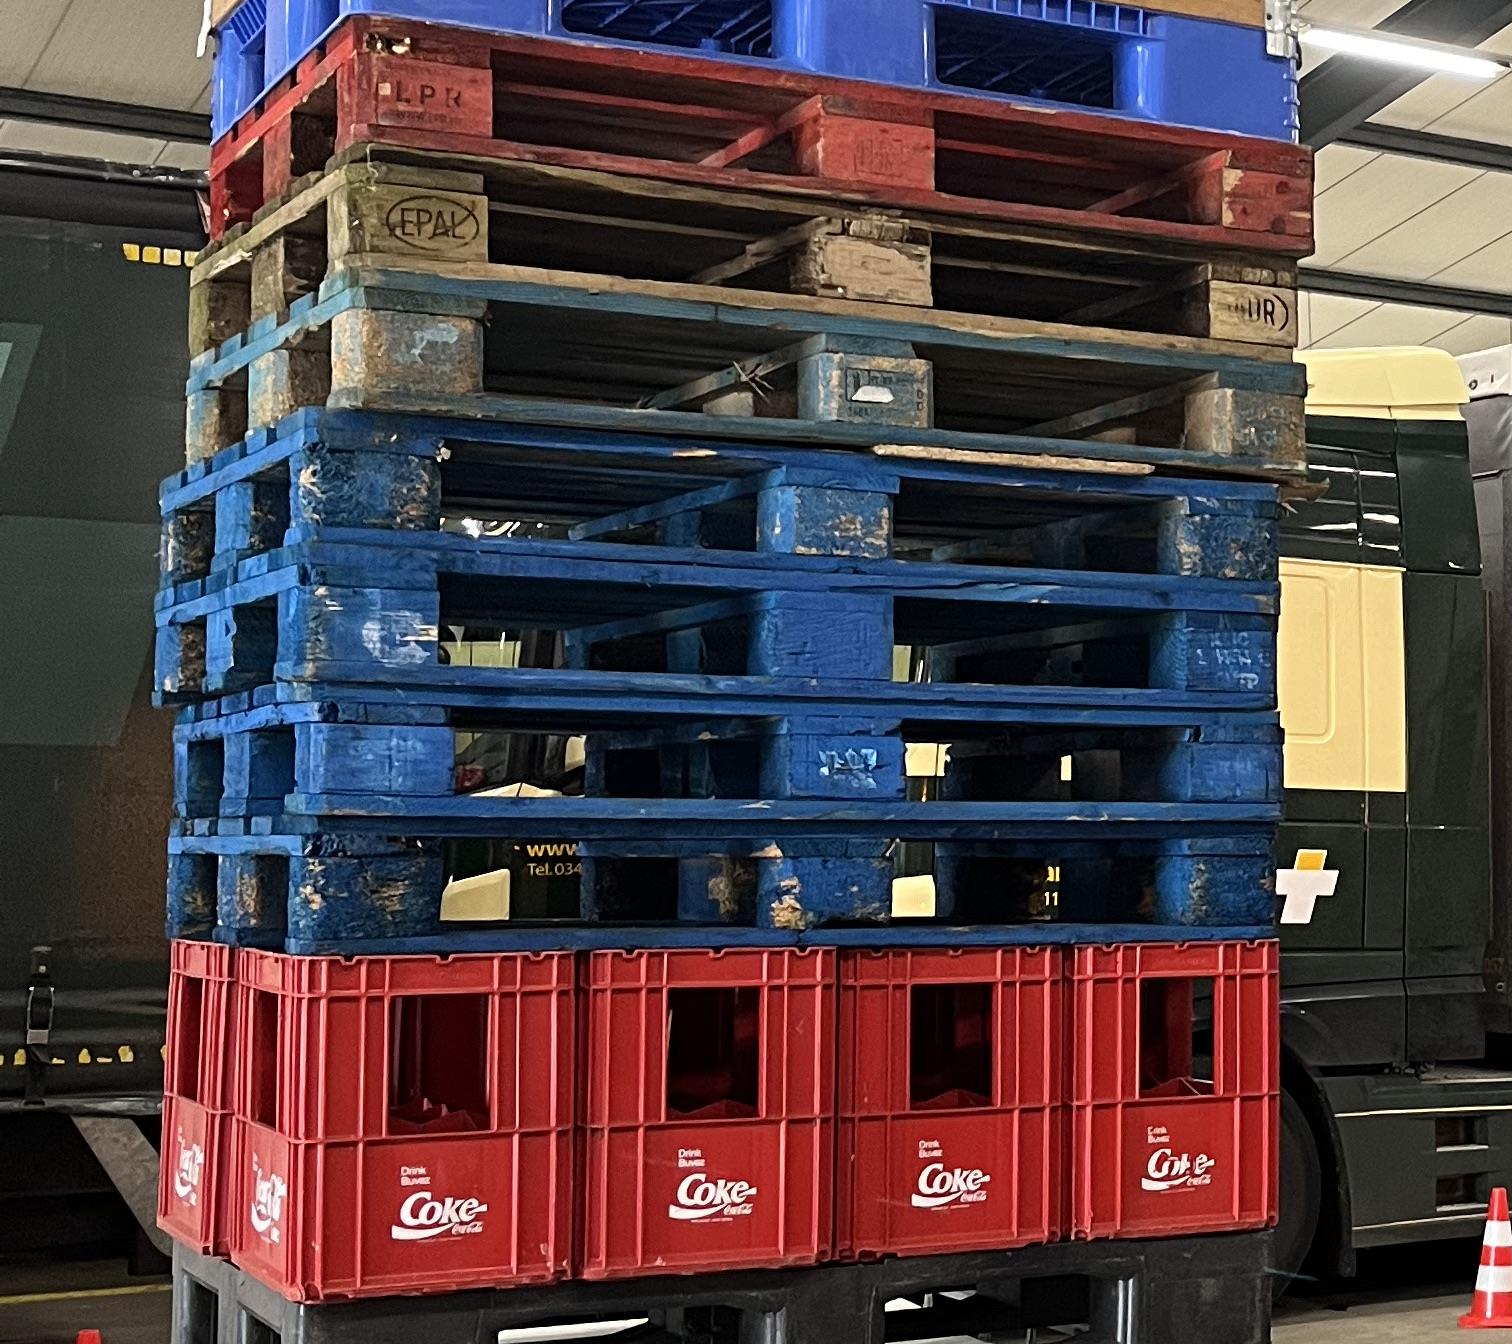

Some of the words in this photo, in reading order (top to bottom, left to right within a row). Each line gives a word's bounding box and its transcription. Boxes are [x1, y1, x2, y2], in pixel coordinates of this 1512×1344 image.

[401, 207, 466, 240] EPAL
[677, 1173, 757, 1207] Coke
[918, 1163, 991, 1196] Coke
[399, 1191, 488, 1227] Coke
